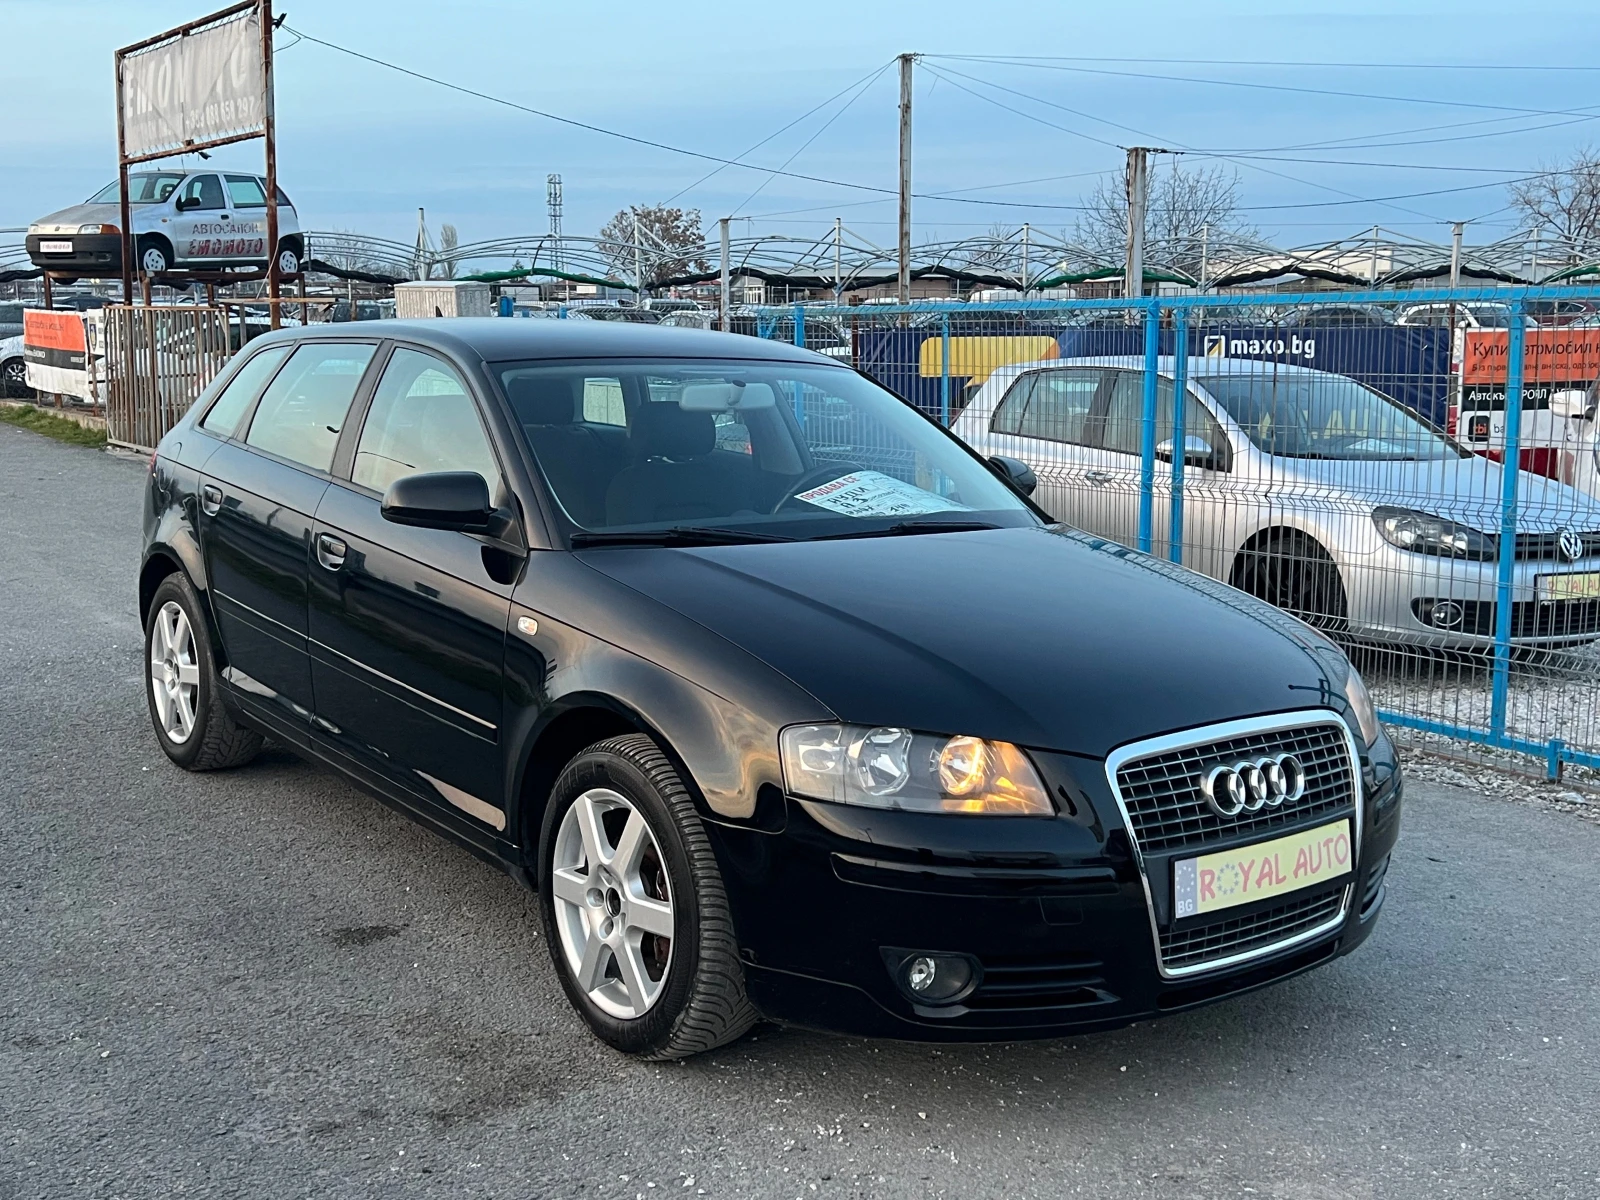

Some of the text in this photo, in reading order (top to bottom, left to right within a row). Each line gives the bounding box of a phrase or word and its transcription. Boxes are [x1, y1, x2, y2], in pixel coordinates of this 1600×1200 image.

[1230, 335, 1315, 359] maxo.bg
[1473, 342, 1508, 359] Купи
[800, 481, 846, 501] ПРОДАВА
[845, 475, 860, 485] СЕ
[1199, 833, 1350, 902] ROYAL AUTO
[1178, 898, 1193, 914] BG
